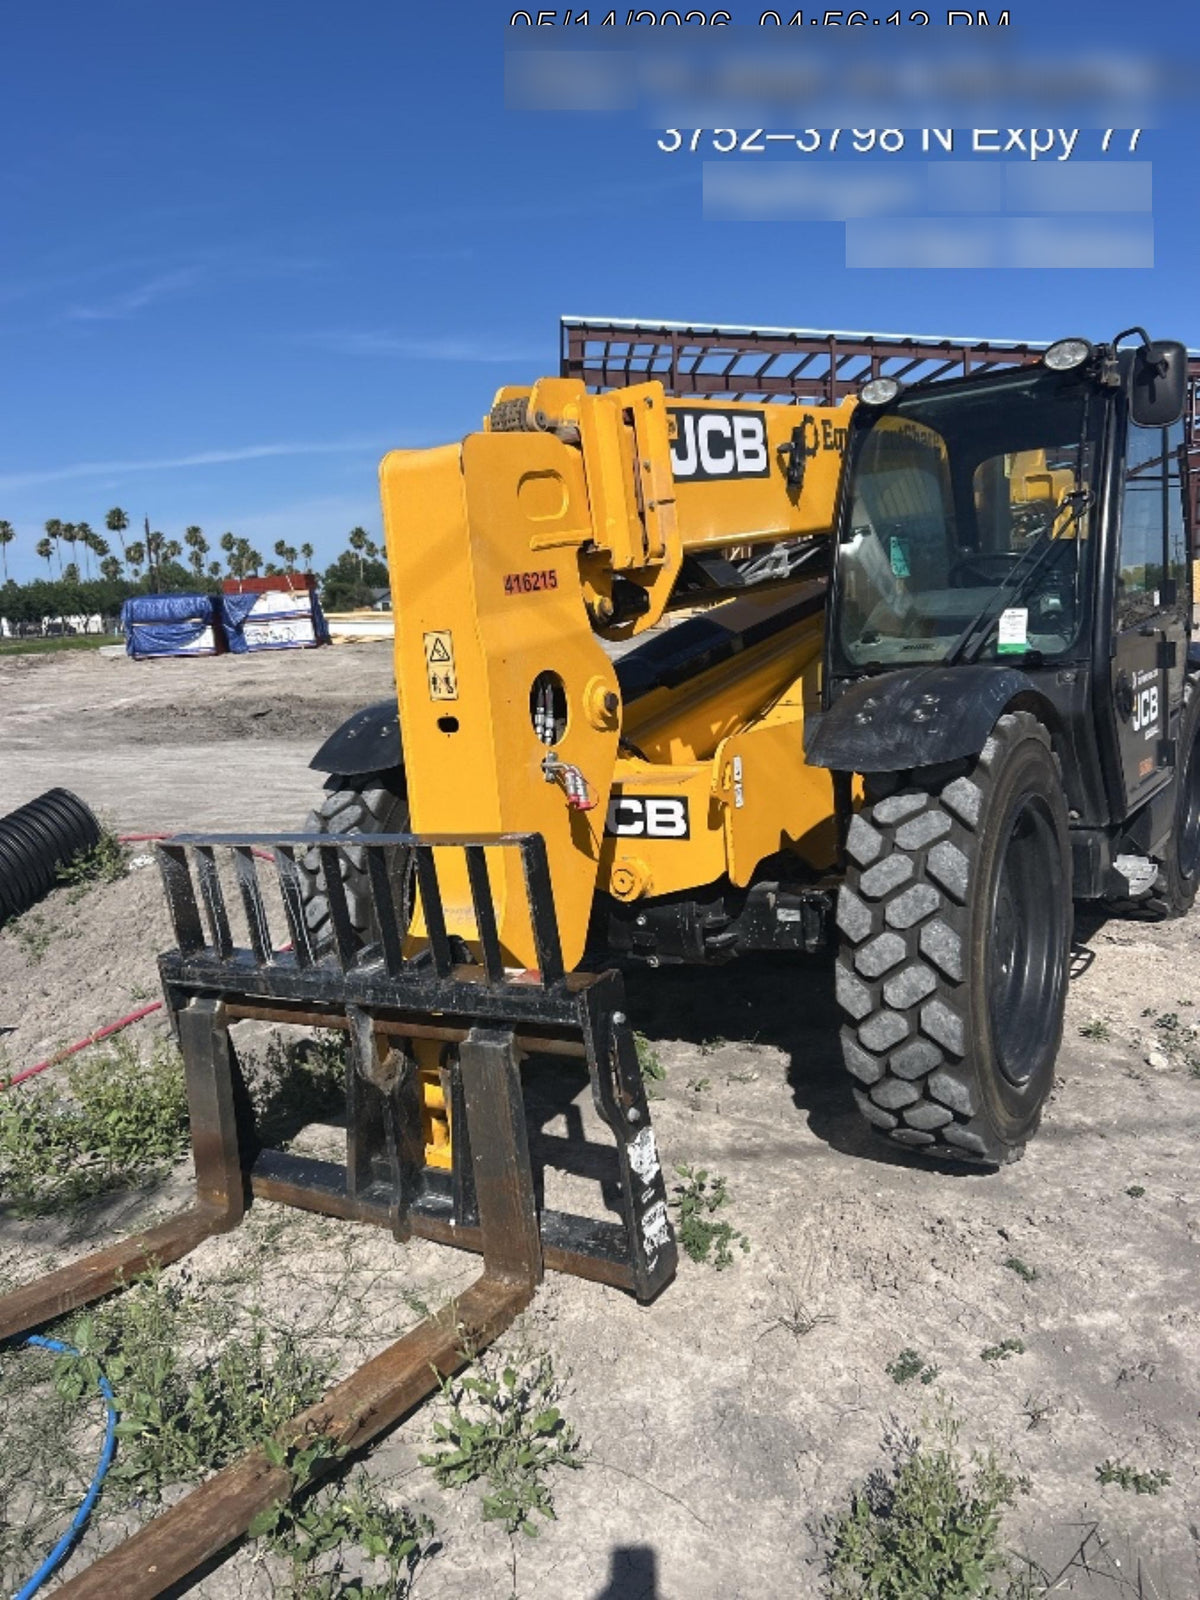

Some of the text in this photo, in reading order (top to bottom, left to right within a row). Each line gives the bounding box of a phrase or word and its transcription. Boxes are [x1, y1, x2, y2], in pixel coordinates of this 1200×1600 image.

[670, 414, 767, 476] JCB
[504, 569, 558, 595] 416215
[1132, 685, 1159, 732] JCB
[606, 799, 687, 837] CB
